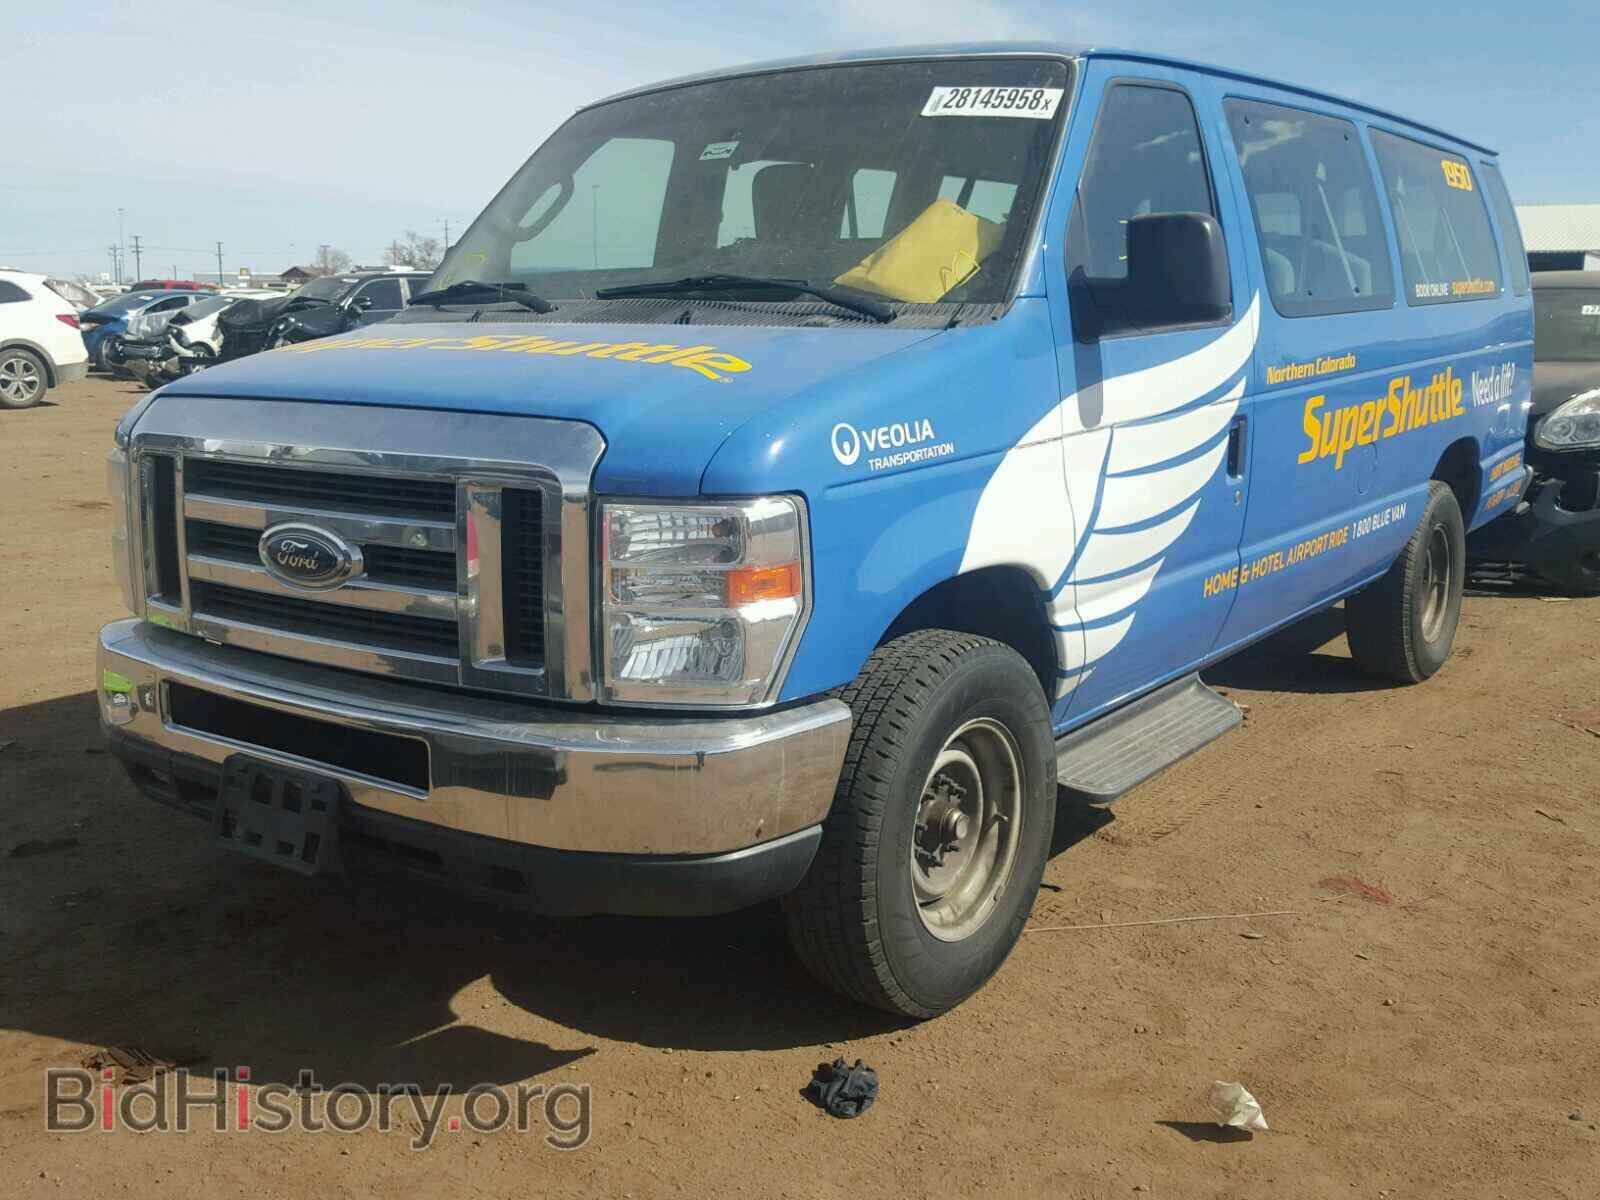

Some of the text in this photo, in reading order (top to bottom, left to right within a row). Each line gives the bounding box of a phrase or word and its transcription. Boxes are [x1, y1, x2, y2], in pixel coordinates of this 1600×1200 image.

[1441, 160, 1472, 191] 1950
[1266, 353, 1356, 385] Northern Colorado
[1472, 366, 1494, 409] Need
[1297, 366, 1466, 470] SuperShuttle
[862, 418, 935, 452] VEOLIA
[868, 442, 955, 472] TRANSPORTATION
[277, 539, 320, 570] Ford
[1203, 502, 1407, 598] HOME & HOTEL AIRPORT RIDE 1 800 BLUE VAN
